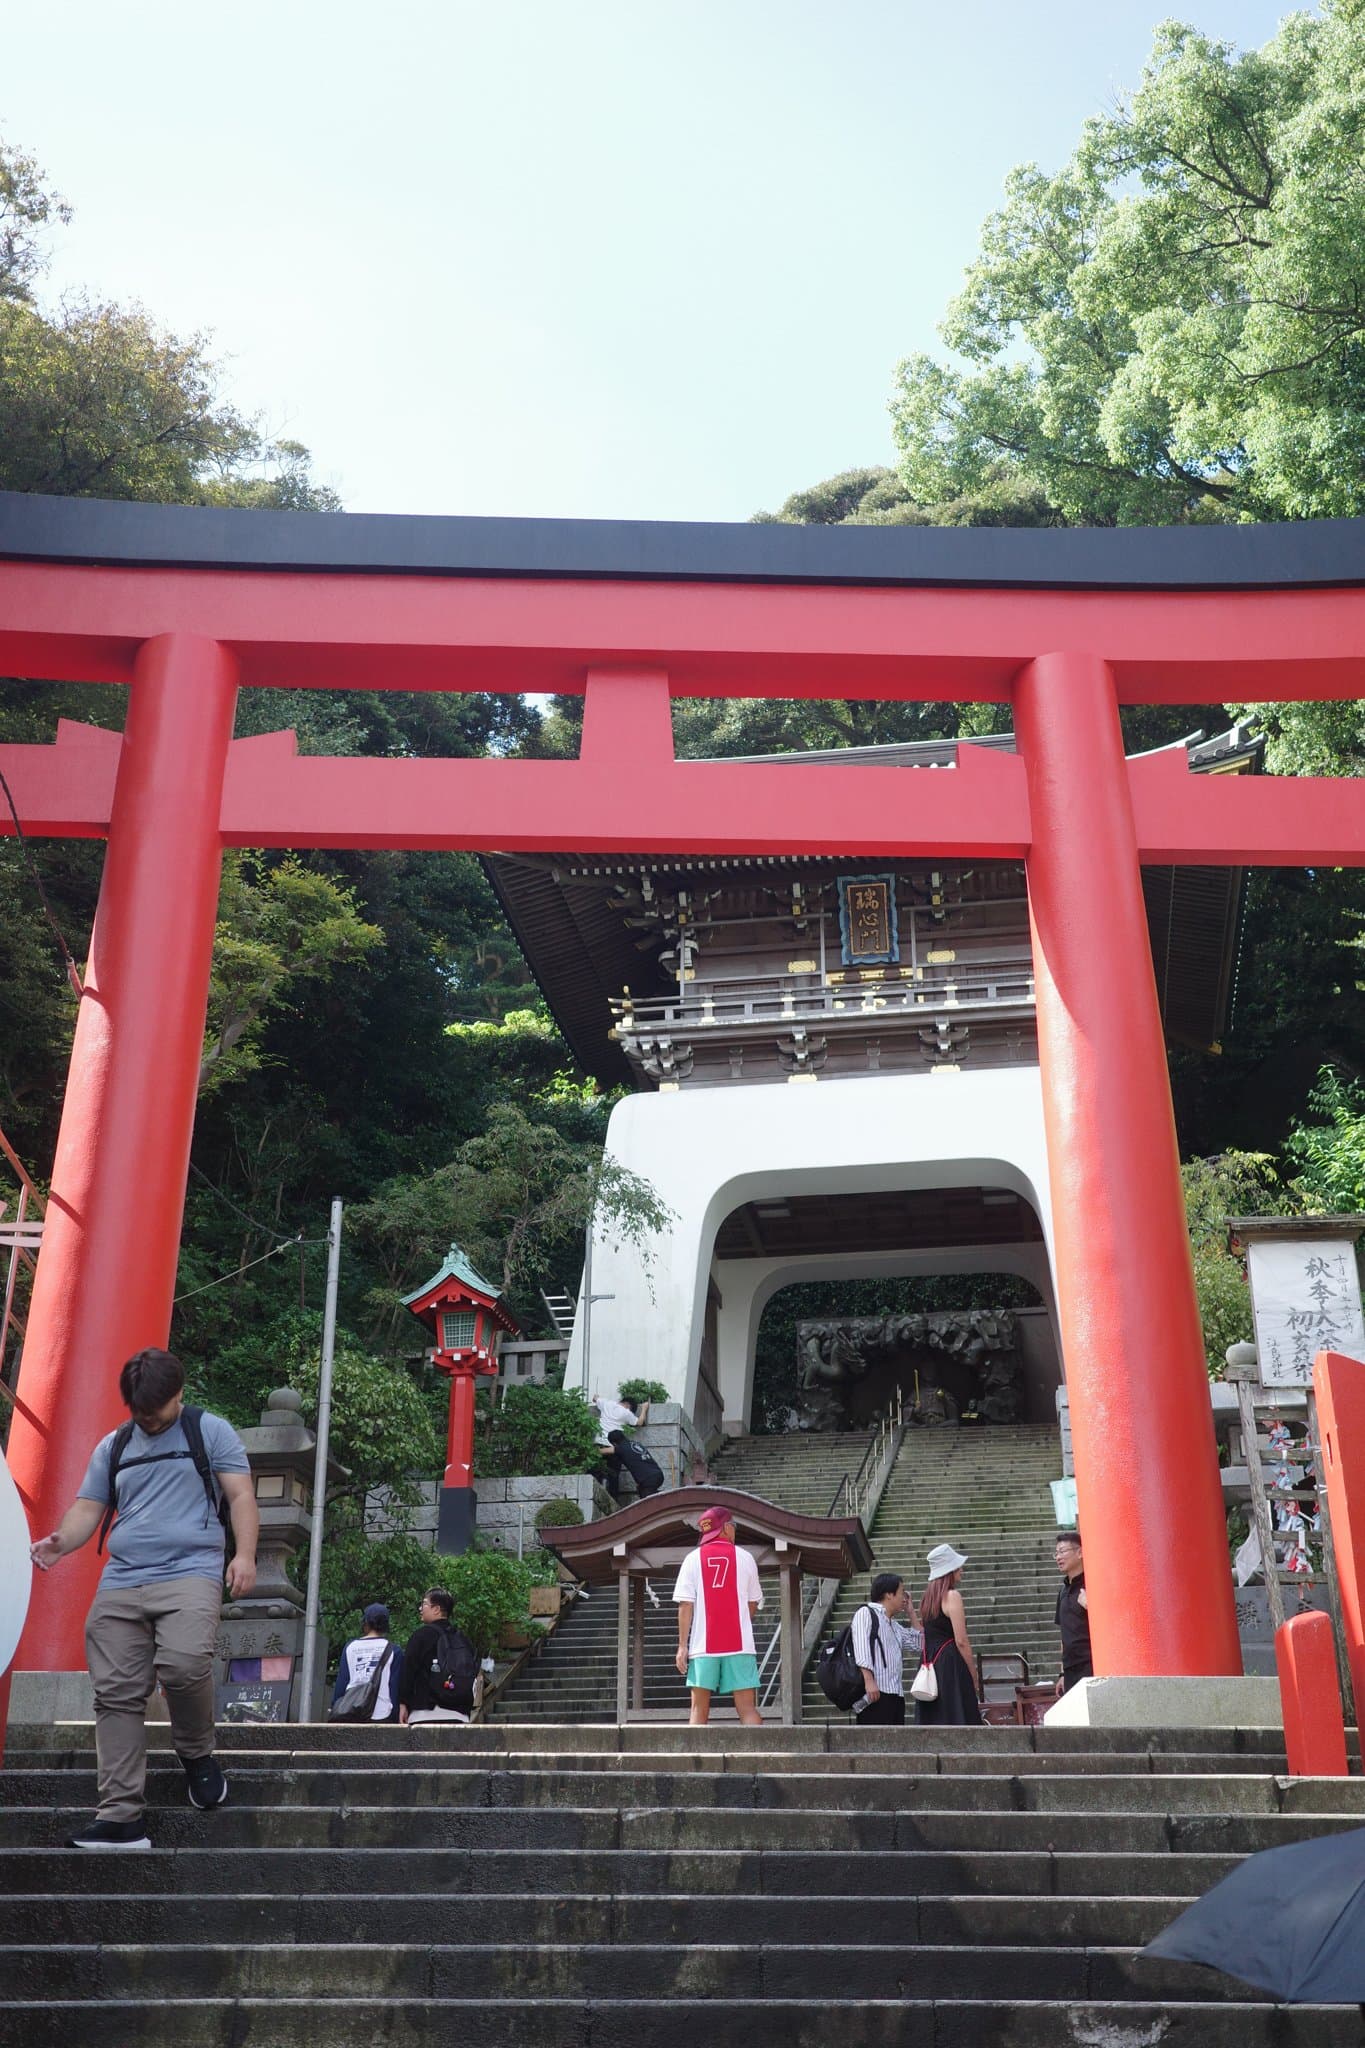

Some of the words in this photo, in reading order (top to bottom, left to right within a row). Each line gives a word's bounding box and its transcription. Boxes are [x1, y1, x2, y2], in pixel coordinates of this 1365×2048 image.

[855, 887, 881, 951] 瑞心門
[707, 1556, 730, 1589] 7
